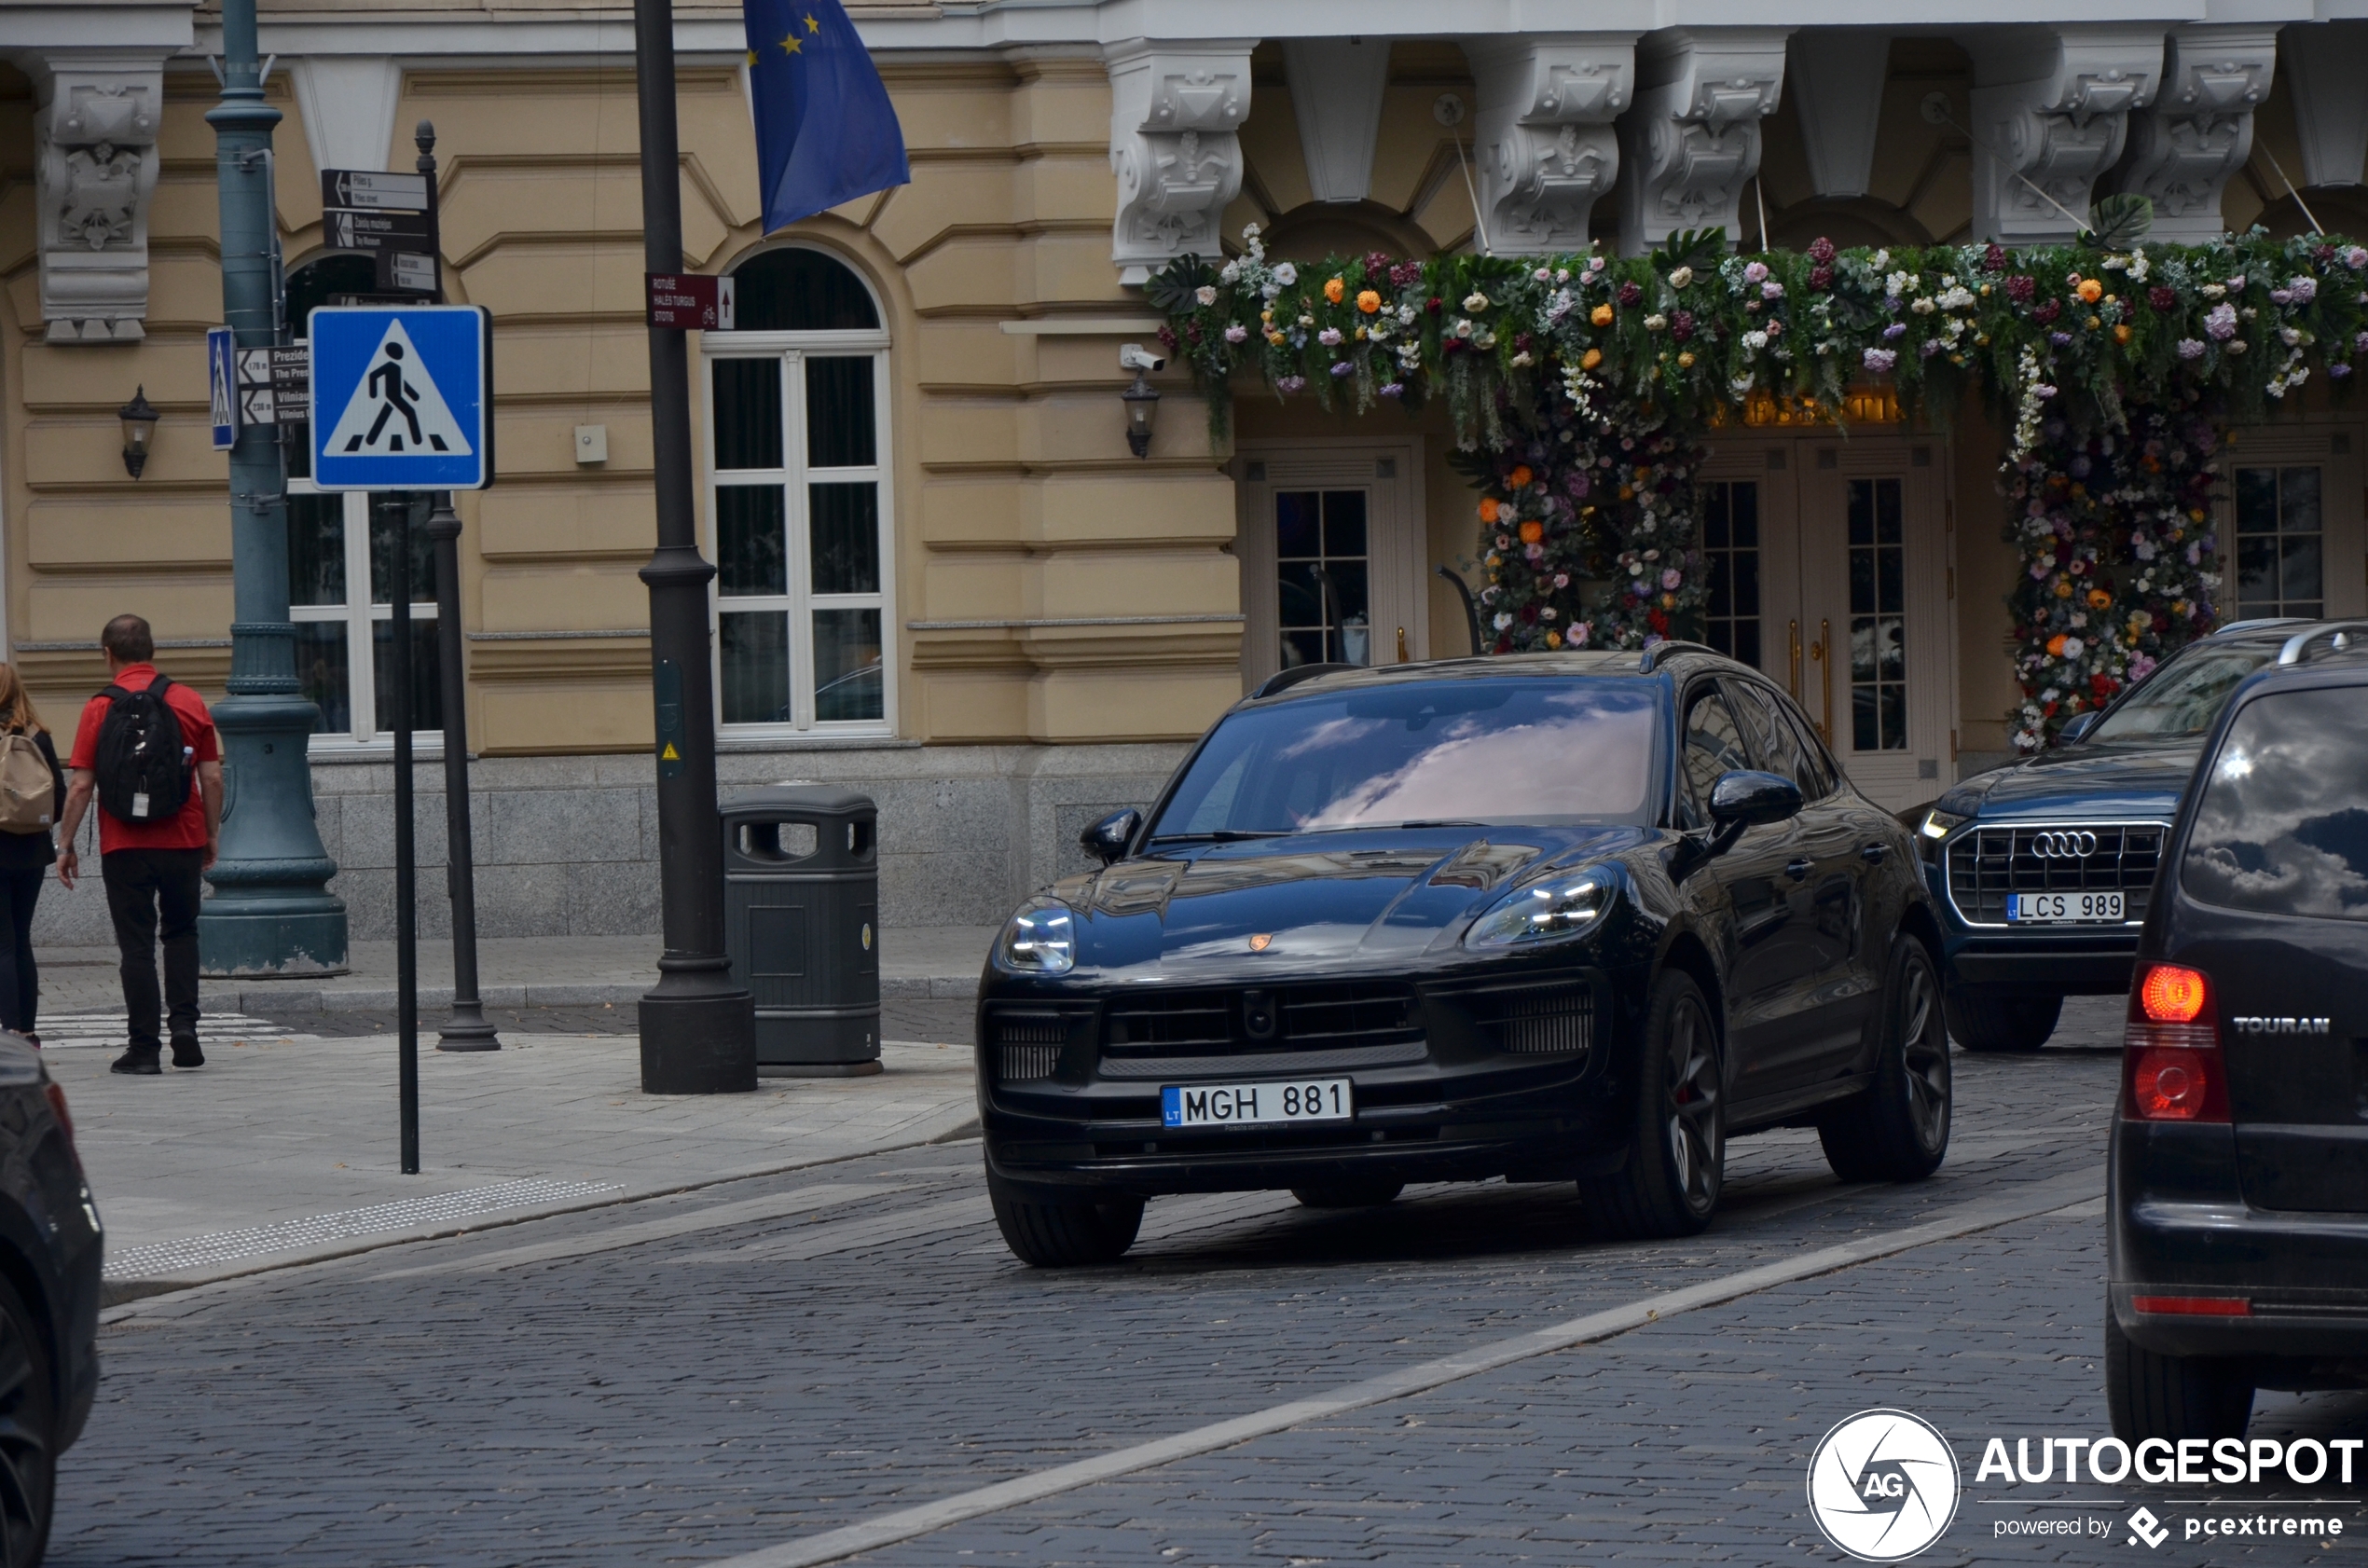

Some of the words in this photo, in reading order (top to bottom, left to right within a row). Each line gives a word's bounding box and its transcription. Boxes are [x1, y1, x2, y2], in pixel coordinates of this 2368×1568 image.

[673, 296, 695, 307] TURGUS
[654, 310, 675, 322] STOTIS
[274, 369, 290, 378] The
[278, 410, 305, 420] Vilnius
[2019, 896, 2065, 917] LCS
[2082, 895, 2121, 916] 989
[2233, 1017, 2330, 1033] TOURAN
[1166, 1110, 1179, 1121] LT
[1186, 1087, 1258, 1121] MGH
[1283, 1083, 1340, 1116] 881
